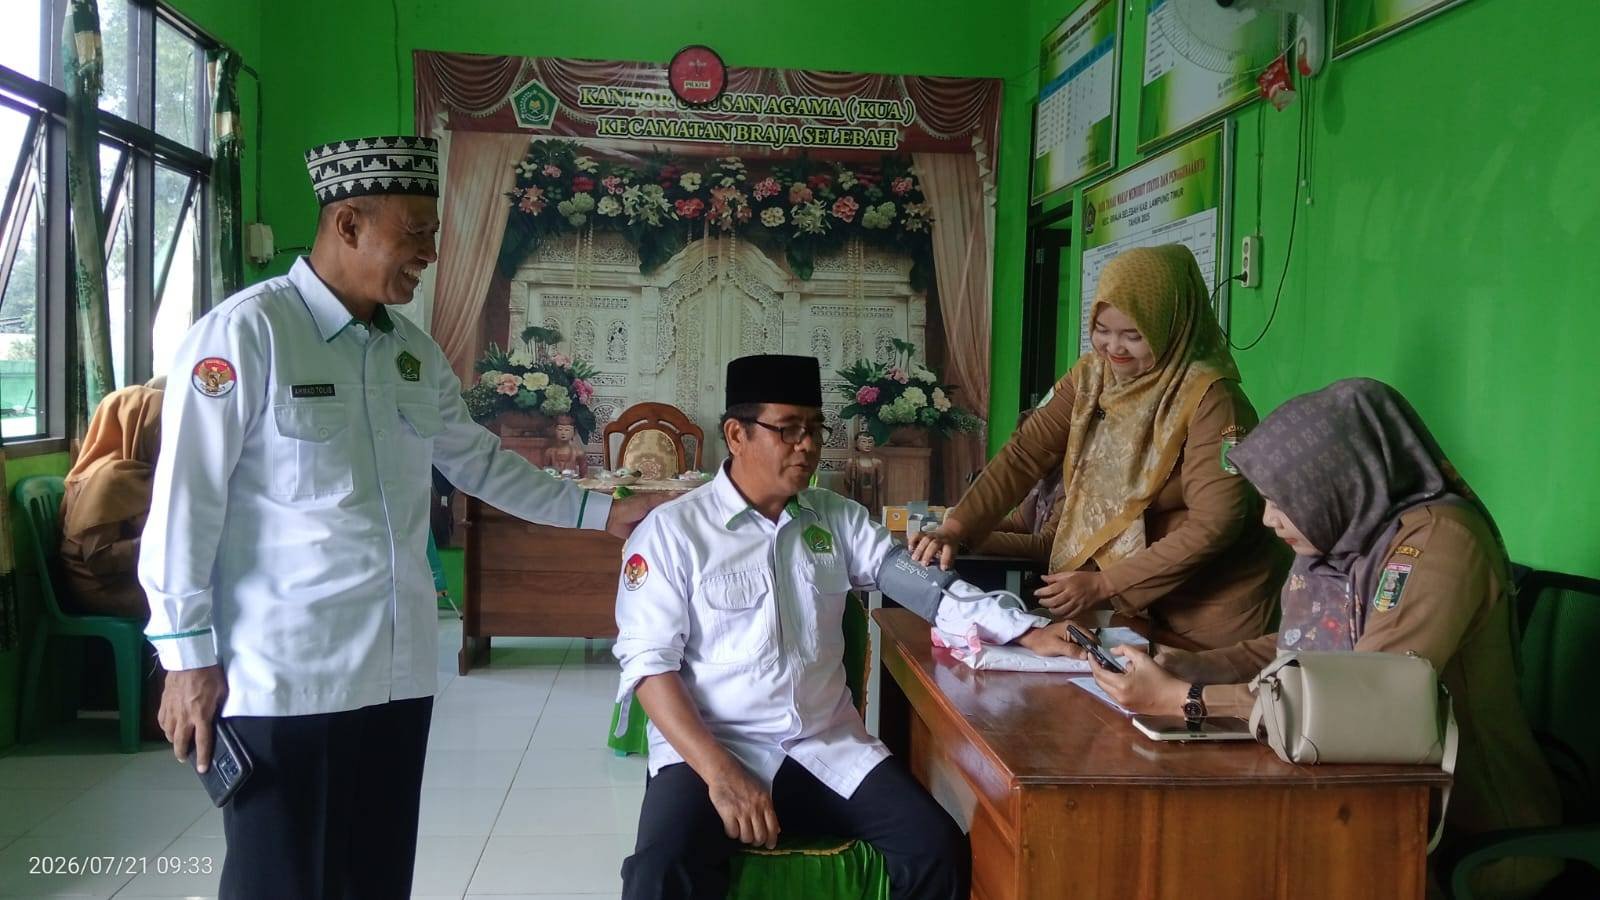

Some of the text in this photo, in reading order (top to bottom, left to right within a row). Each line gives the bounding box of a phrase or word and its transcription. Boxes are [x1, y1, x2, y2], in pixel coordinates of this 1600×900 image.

[579, 86, 673, 108] KANTOR
[676, 91, 764, 113] UUSAN
[764, 95, 845, 117] AGAMA
[599, 117, 897, 149] KECAMATAN BRAJA SELEBAH
